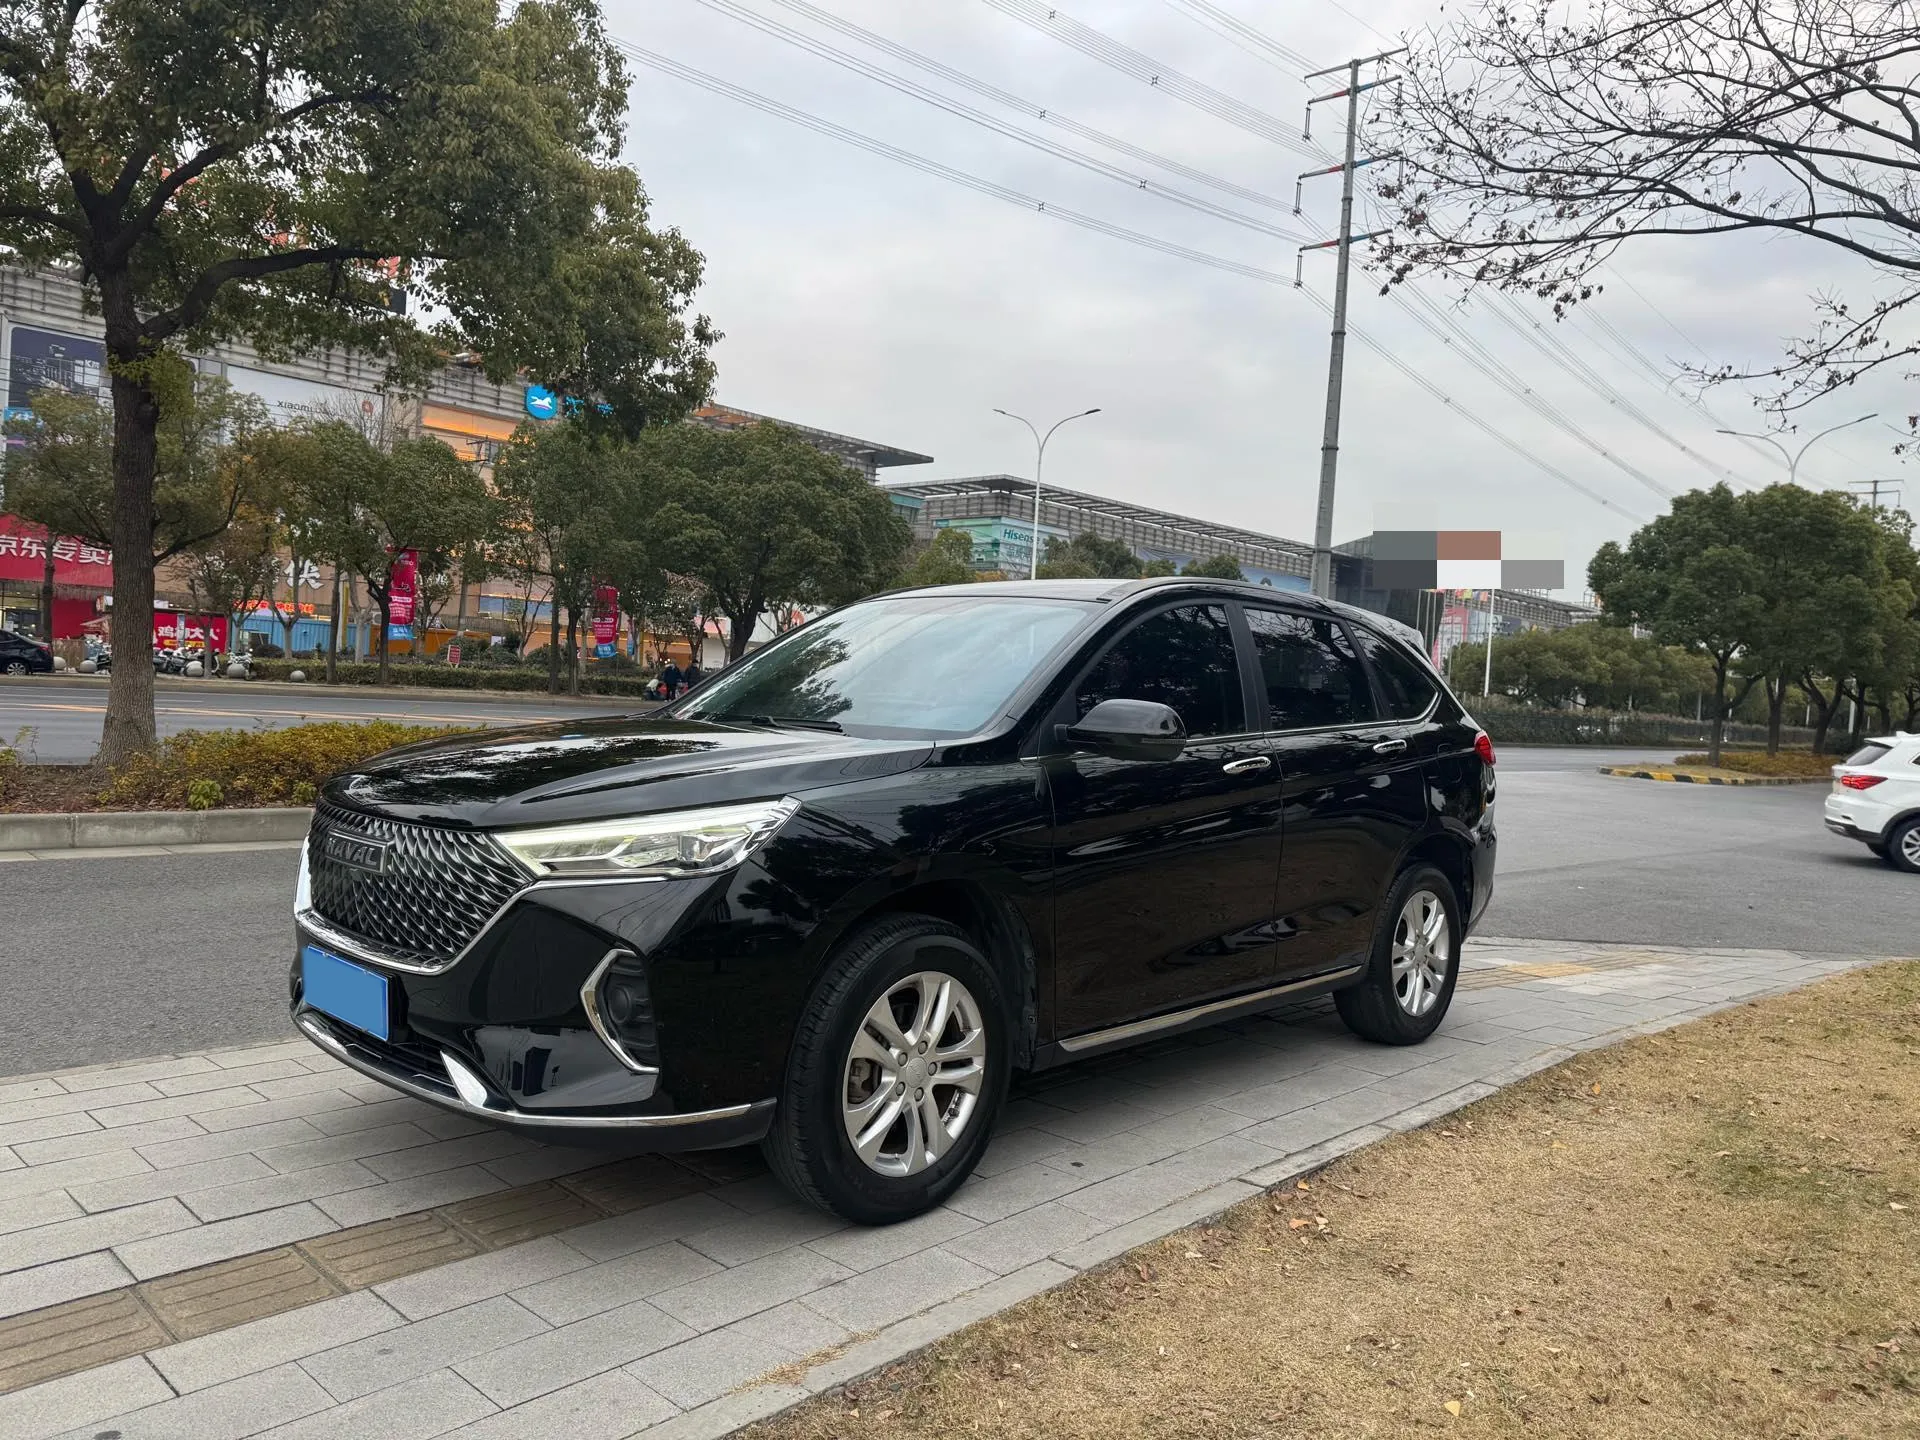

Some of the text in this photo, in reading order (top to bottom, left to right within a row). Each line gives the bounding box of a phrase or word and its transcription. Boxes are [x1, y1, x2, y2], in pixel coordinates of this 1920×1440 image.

[277, 401, 313, 412] xiaomi
[0, 534, 113, 566] 京东专卖
[326, 837, 378, 867] HAVAL
